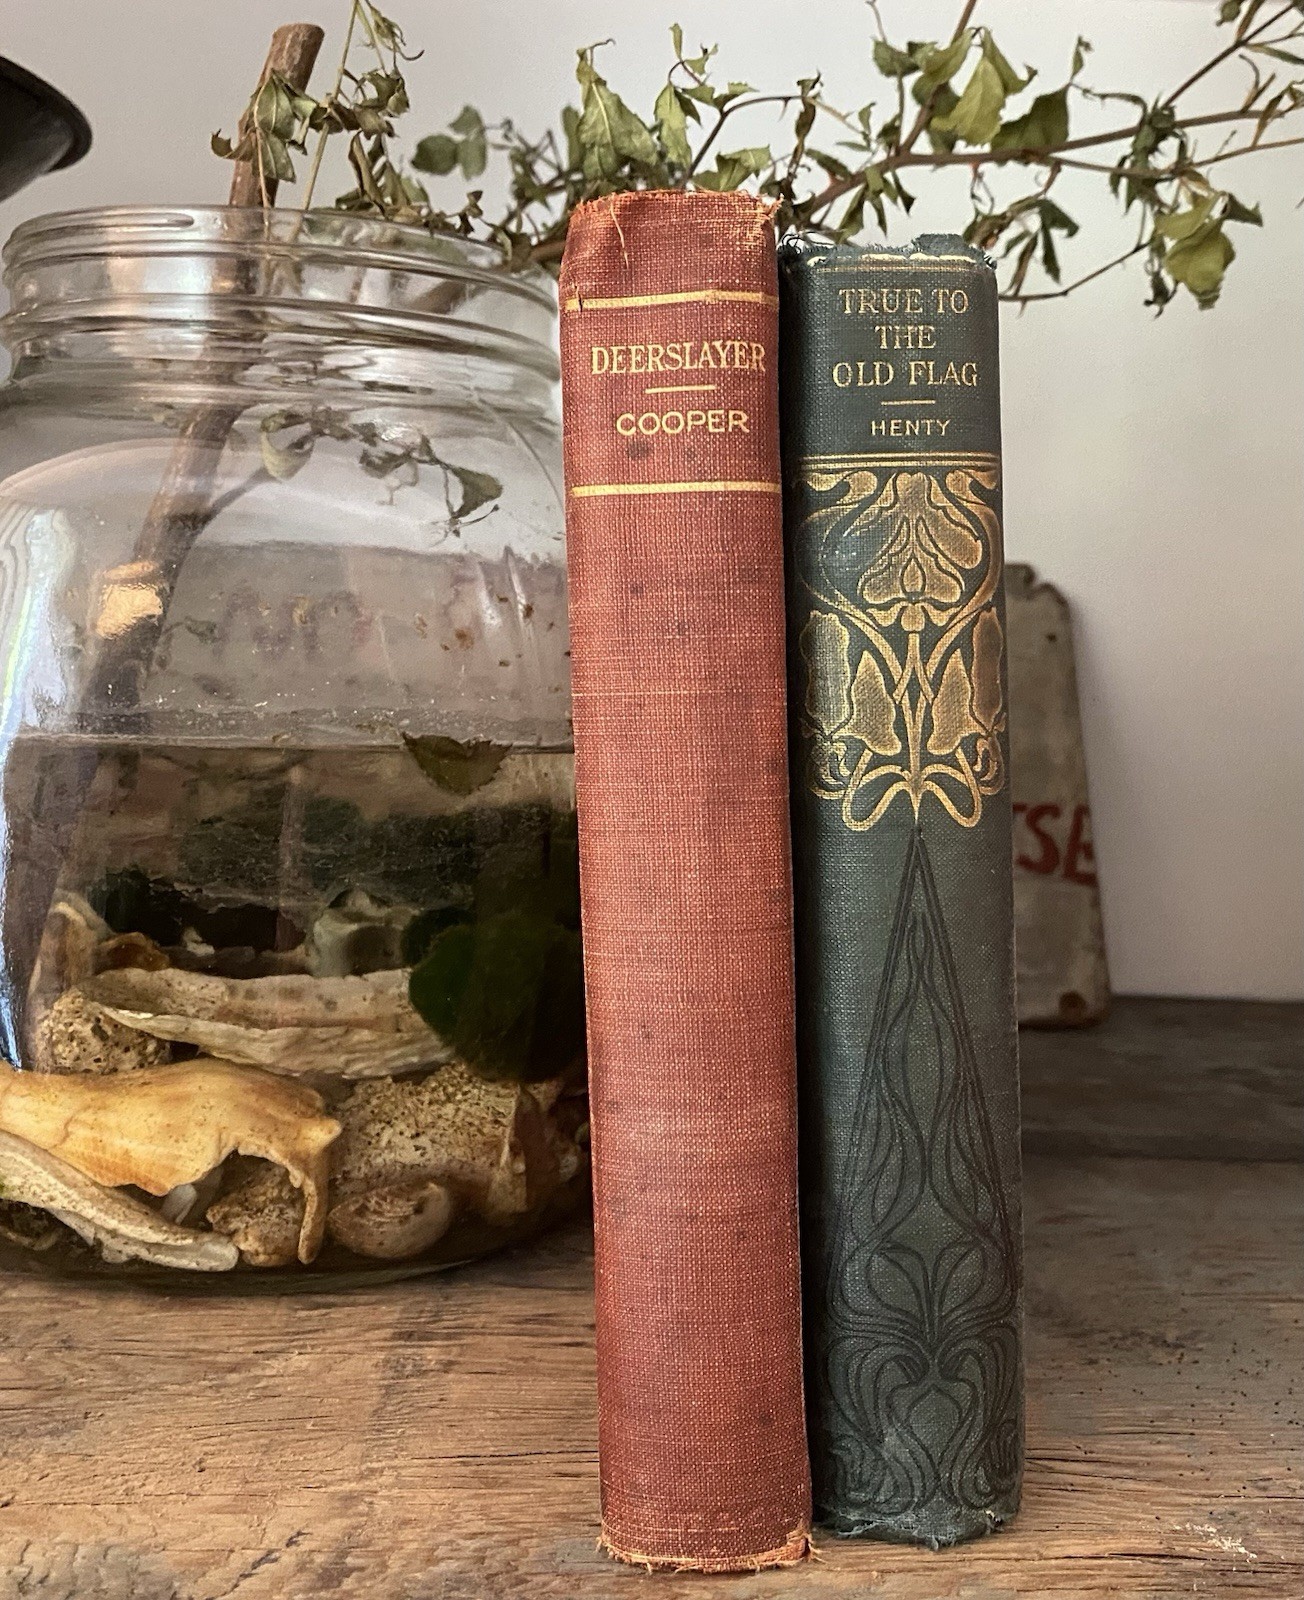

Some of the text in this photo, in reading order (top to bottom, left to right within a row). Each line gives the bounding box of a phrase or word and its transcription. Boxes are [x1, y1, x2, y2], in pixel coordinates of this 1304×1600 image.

[838, 288, 969, 314] TRUE TO
[874, 325, 936, 349] THE
[592, 340, 765, 374] DEERSLAYER
[832, 361, 978, 387] OLD FLAG
[616, 410, 749, 436] COOPER
[871, 419, 950, 437] HENTY
[1012, 803, 1099, 888] SE
